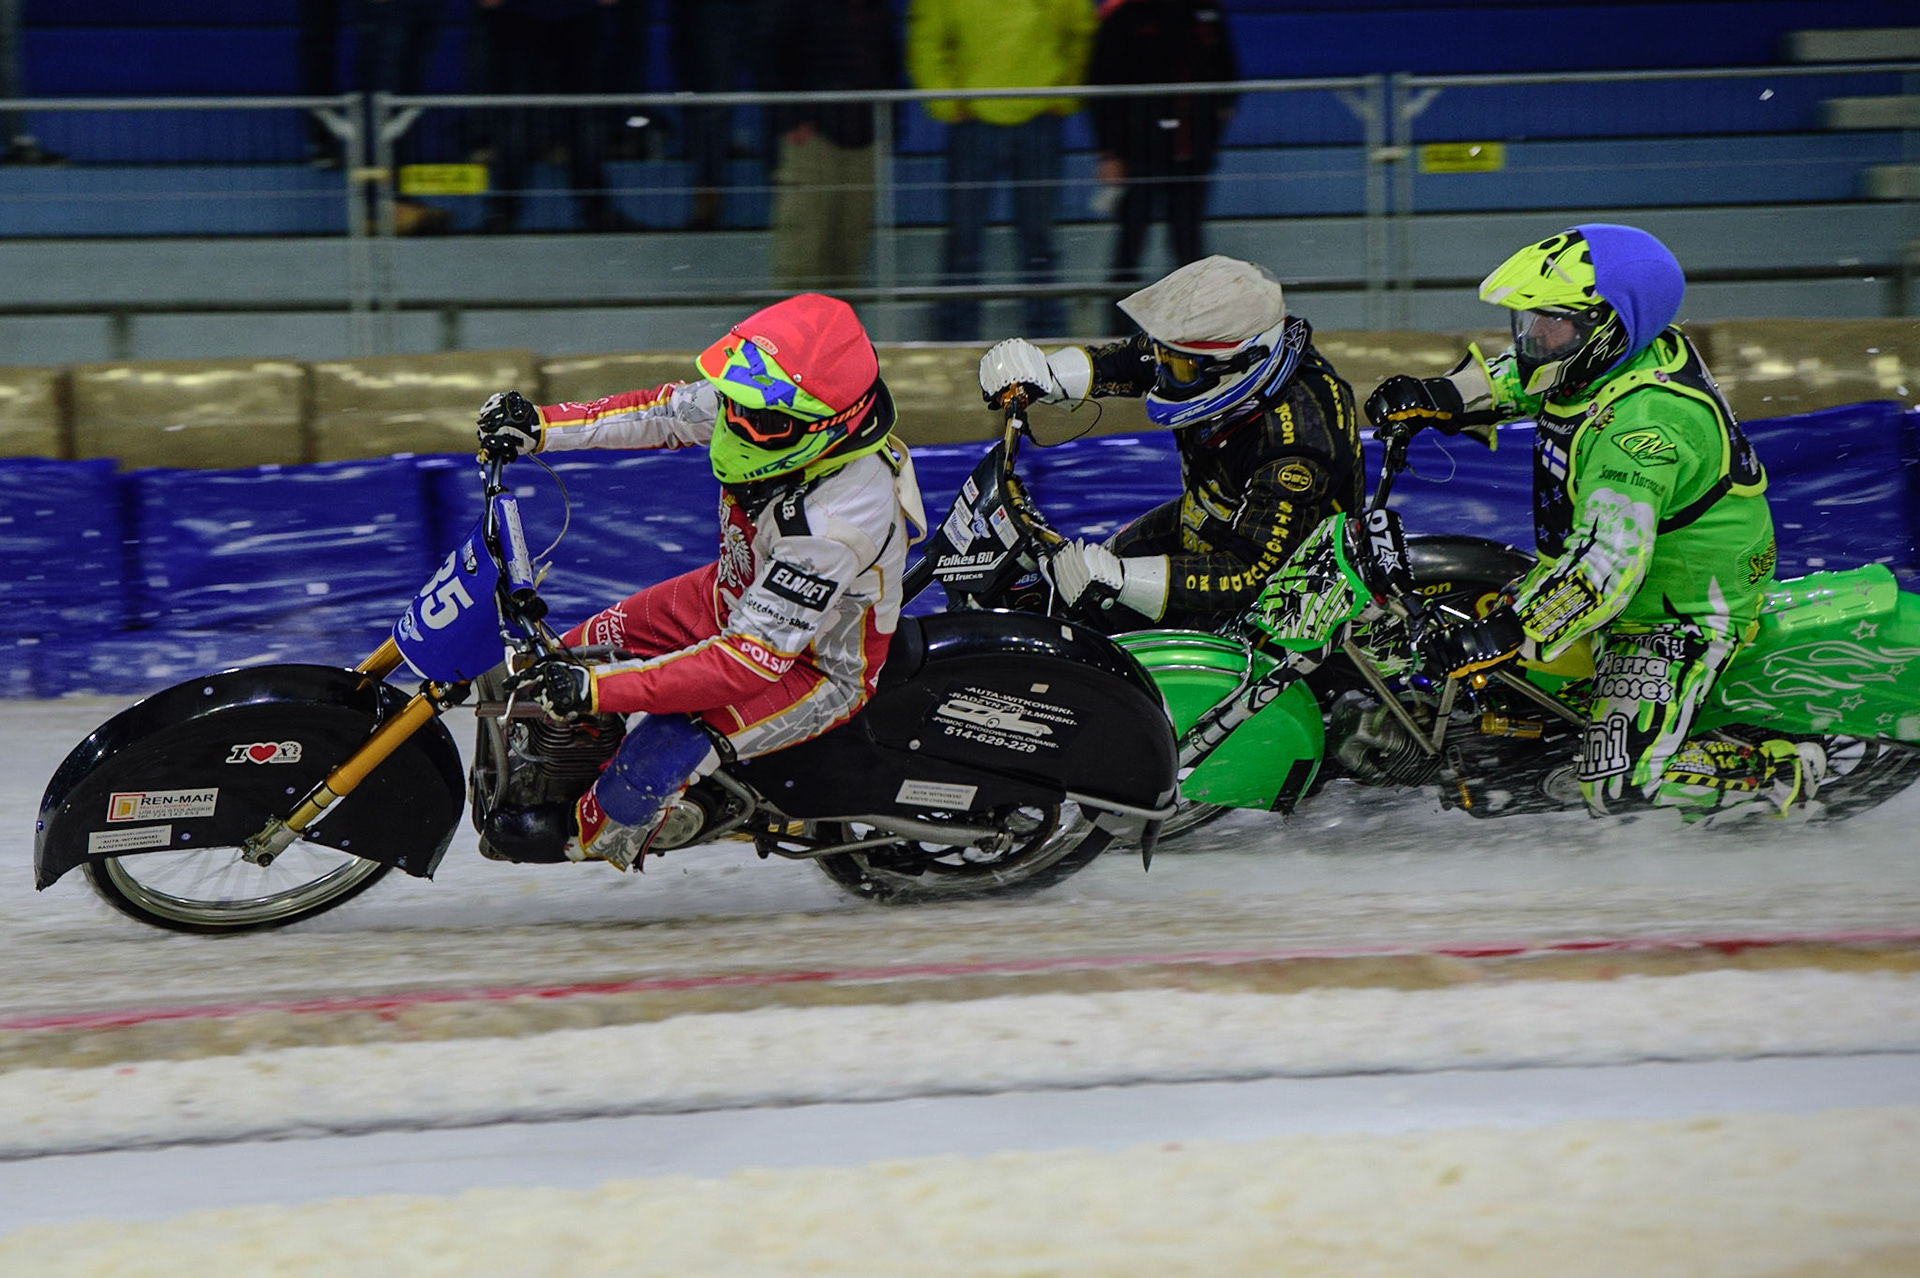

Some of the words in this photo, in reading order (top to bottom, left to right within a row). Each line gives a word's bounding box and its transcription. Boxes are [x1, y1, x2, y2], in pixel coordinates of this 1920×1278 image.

[936, 553, 976, 567] Folkes
[976, 551, 995, 564] Bil
[771, 567, 832, 602] ELNAFT
[1600, 652, 1669, 678] Herra
[943, 725, 1037, 753] 514-629-229
[140, 794, 214, 806] REN-MAR
